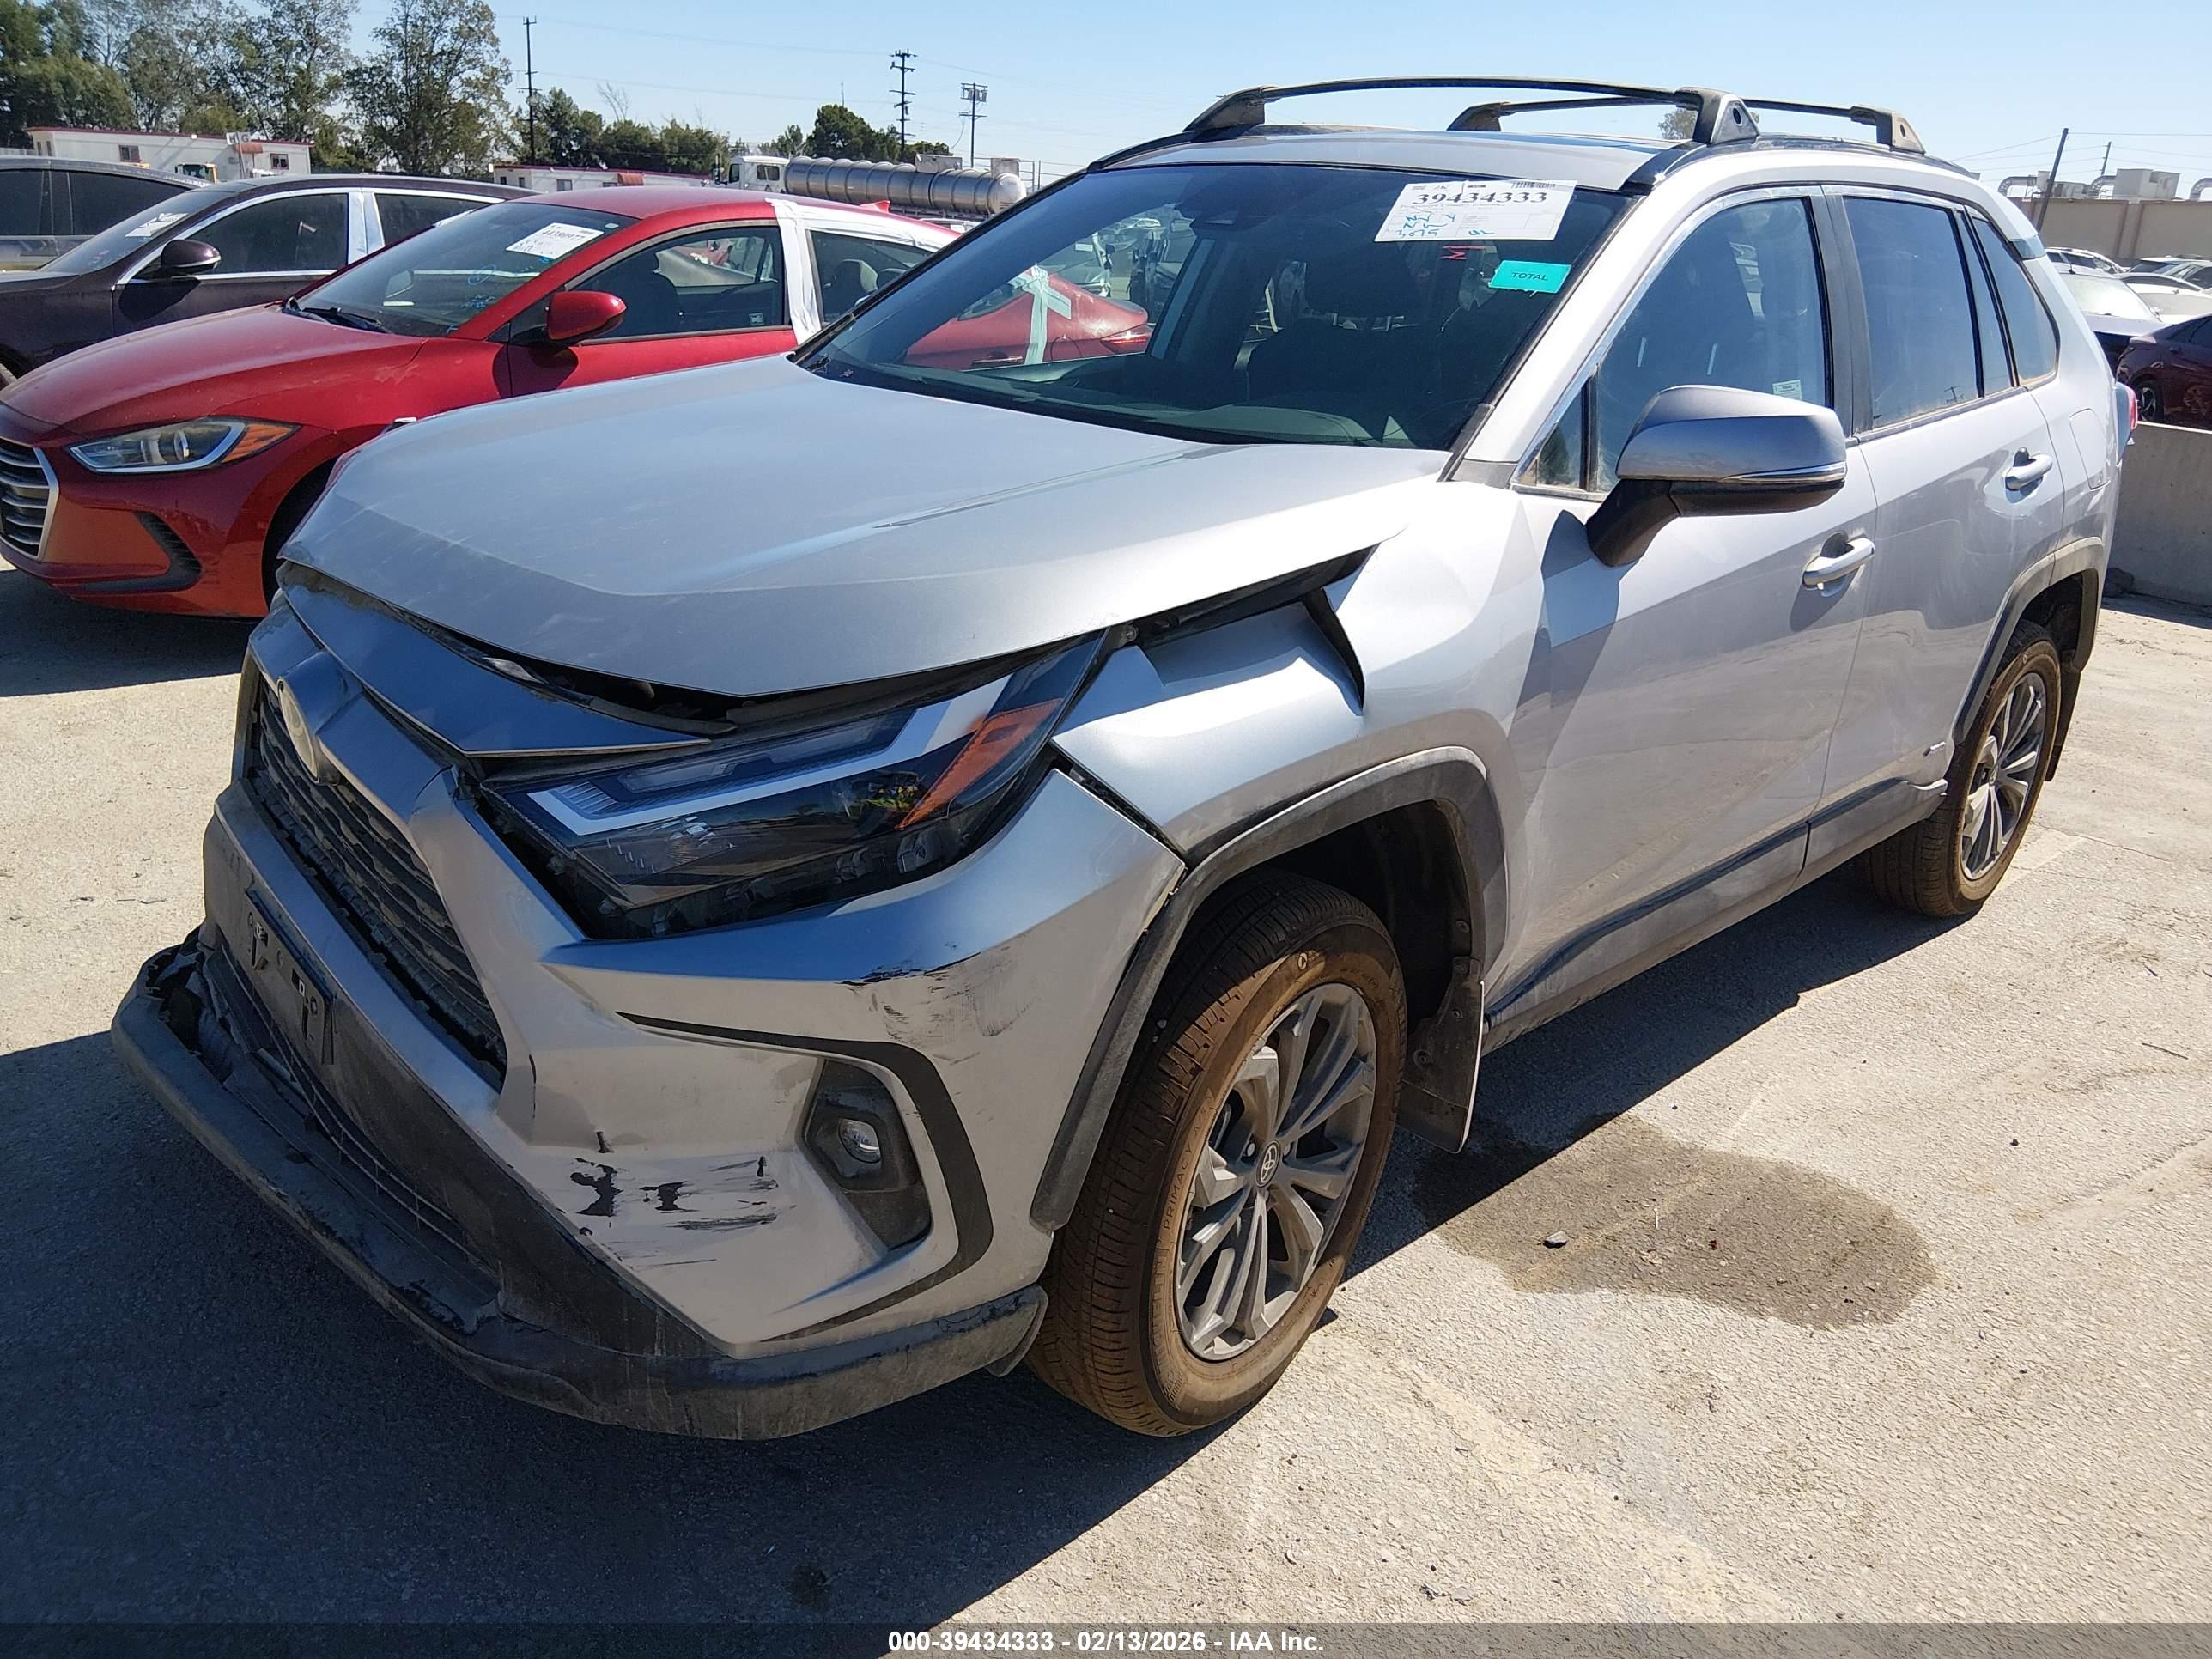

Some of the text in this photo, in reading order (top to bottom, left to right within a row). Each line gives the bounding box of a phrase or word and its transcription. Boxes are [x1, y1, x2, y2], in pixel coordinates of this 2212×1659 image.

[1413, 191, 1547, 205] 39434333
[1511, 272, 1549, 282] TOTAL
[1163, 1144, 1194, 1231] PRIMACY
